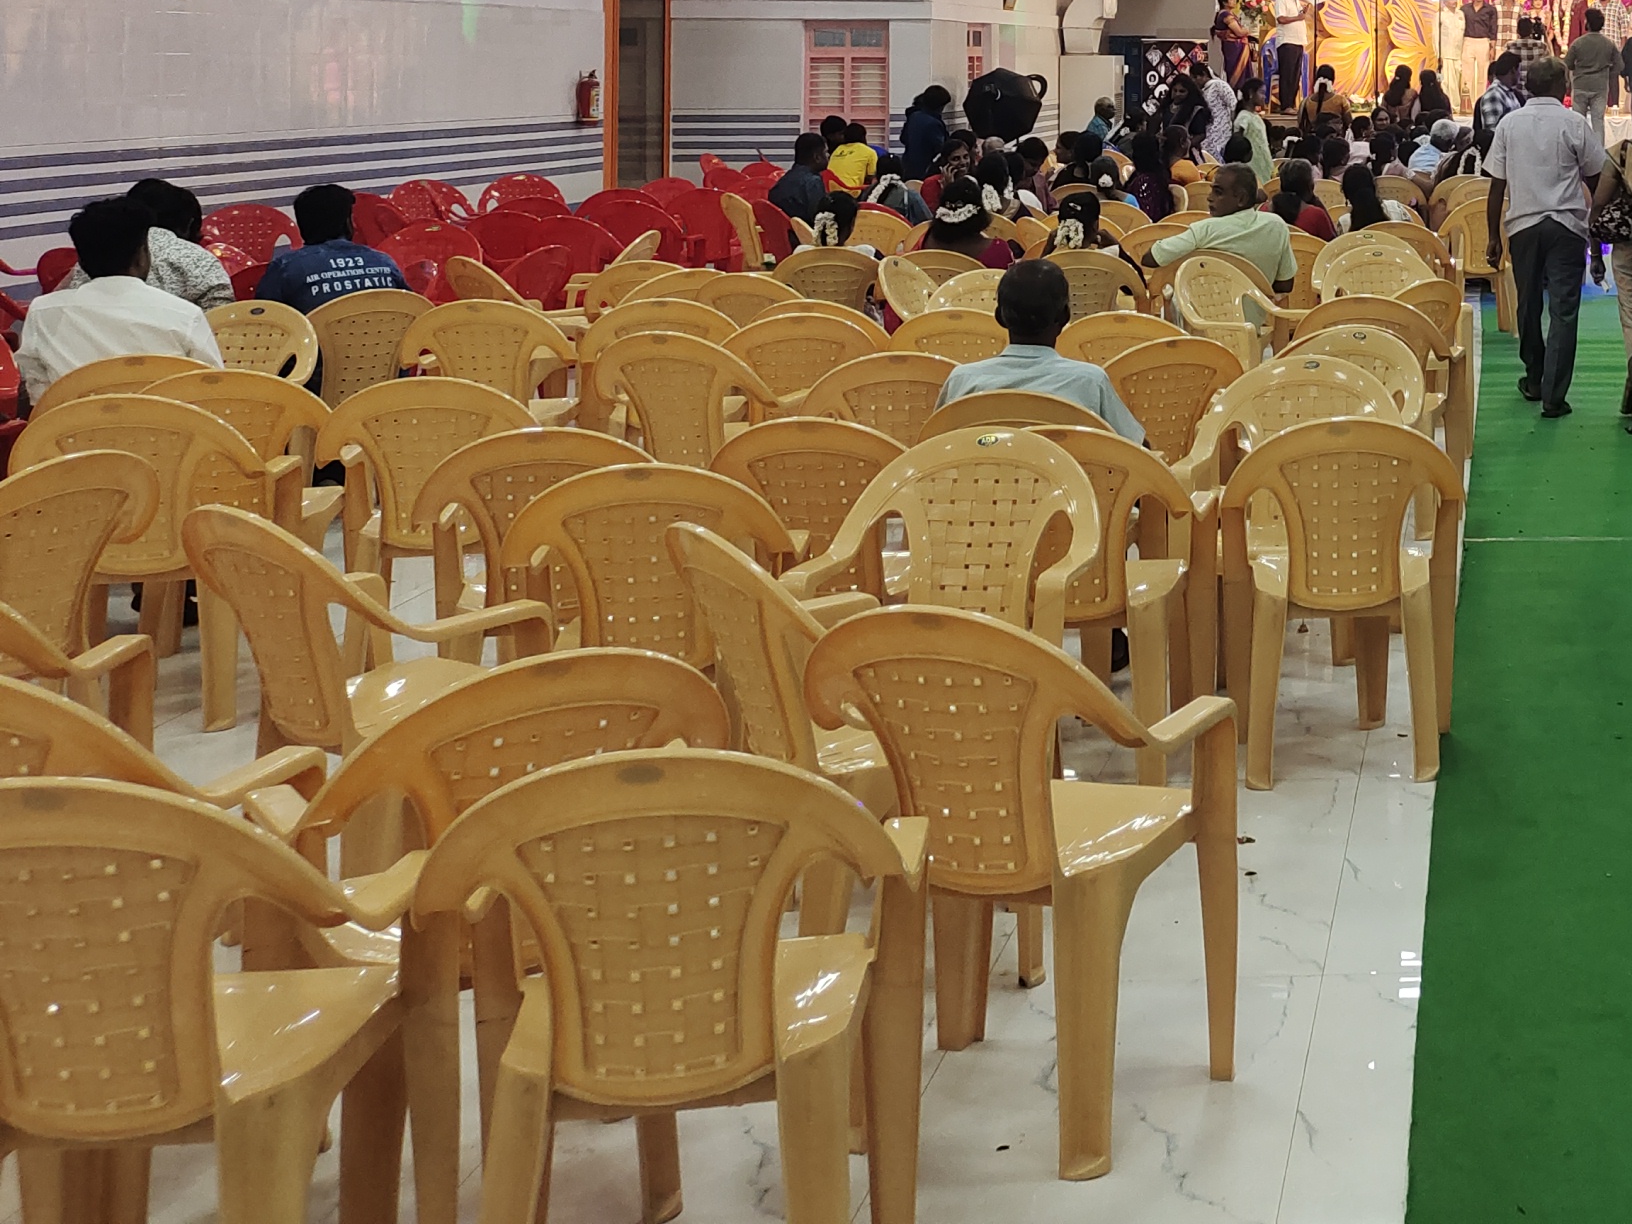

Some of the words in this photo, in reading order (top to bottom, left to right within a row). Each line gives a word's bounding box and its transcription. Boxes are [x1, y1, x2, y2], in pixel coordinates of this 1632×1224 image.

[329, 257, 364, 268] 1923
[306, 273, 321, 284] AIR
[320, 268, 365, 279] OPERATION
[311, 276, 393, 296] PROSTATIC
